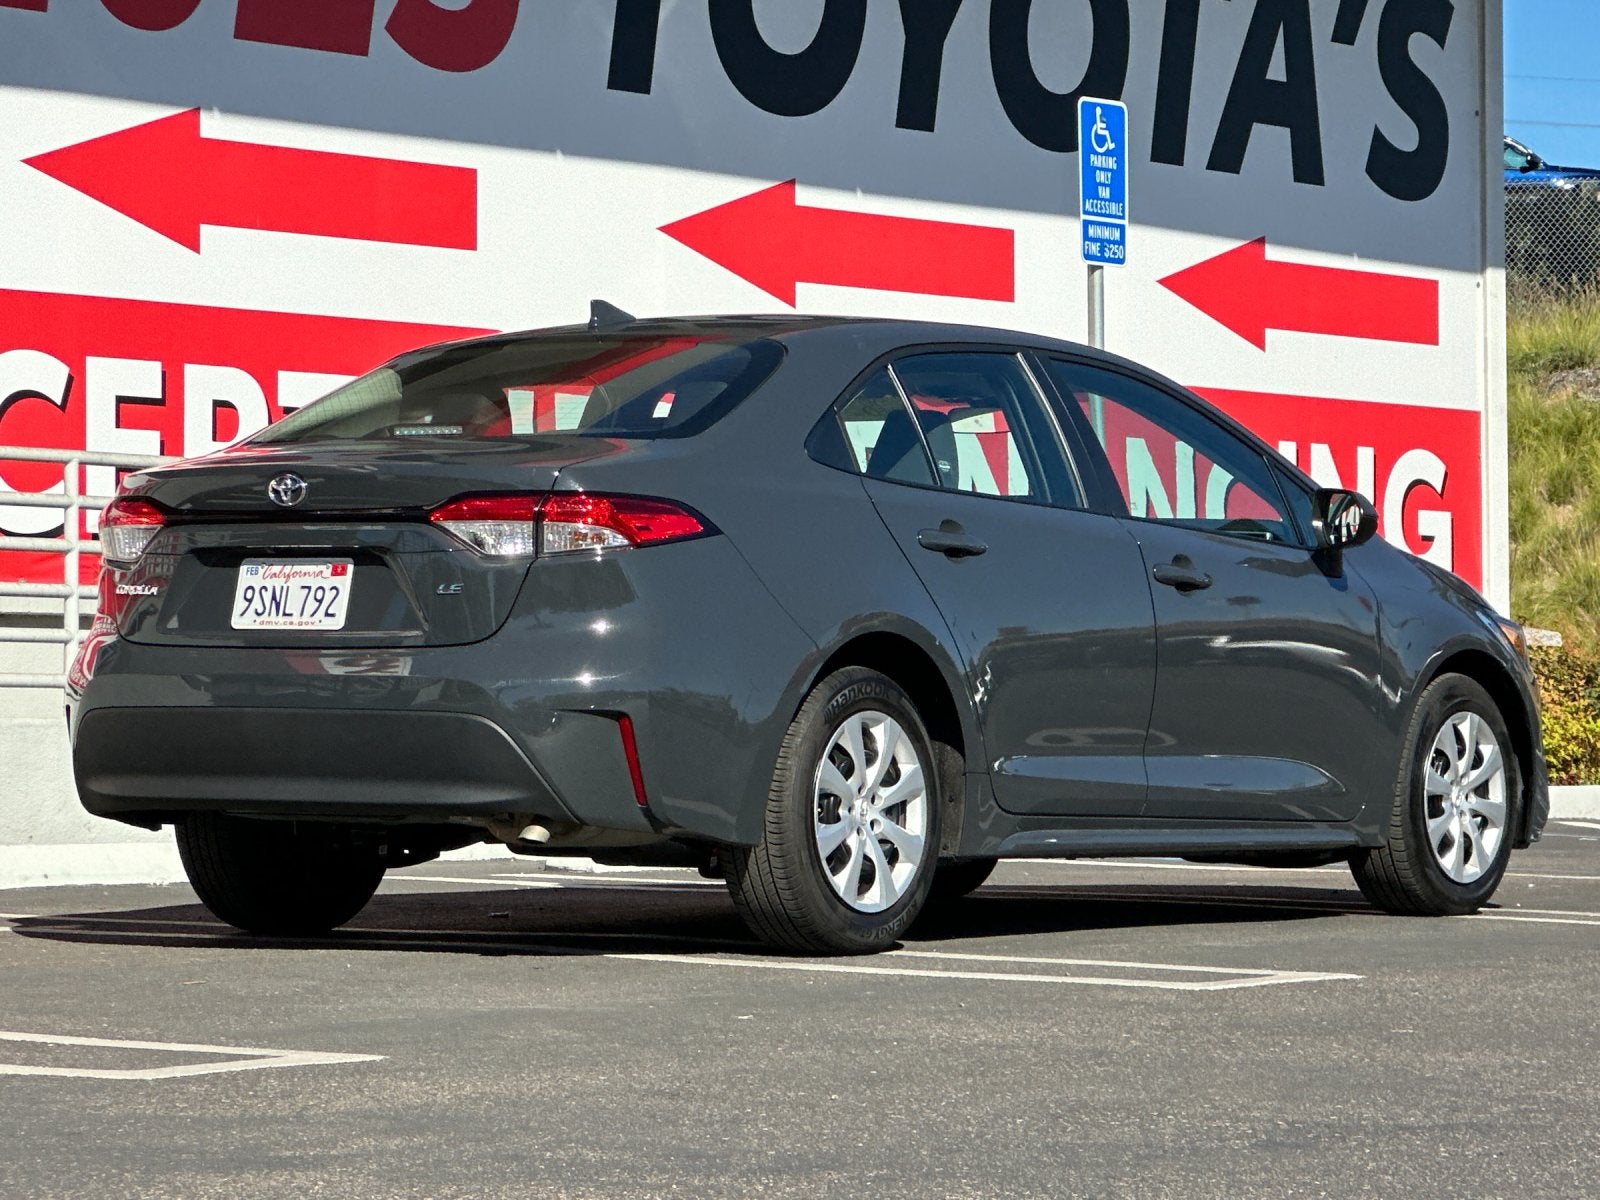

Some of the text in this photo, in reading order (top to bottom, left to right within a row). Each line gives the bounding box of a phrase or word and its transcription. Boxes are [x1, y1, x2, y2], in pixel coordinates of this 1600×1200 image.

[1090, 154, 1117, 170] PARKING
[1095, 170, 1112, 185] ONLY
[1098, 186, 1111, 199] VAN
[1085, 199, 1123, 216] ACCESSIBLE
[1088, 224, 1121, 242] MINIMUM
[1084, 241, 1124, 260] FINE $250
[245, 566, 259, 576] FEB
[262, 563, 330, 584] California
[437, 583, 464, 594] LE
[259, 619, 317, 627] dmv.ca.gov
